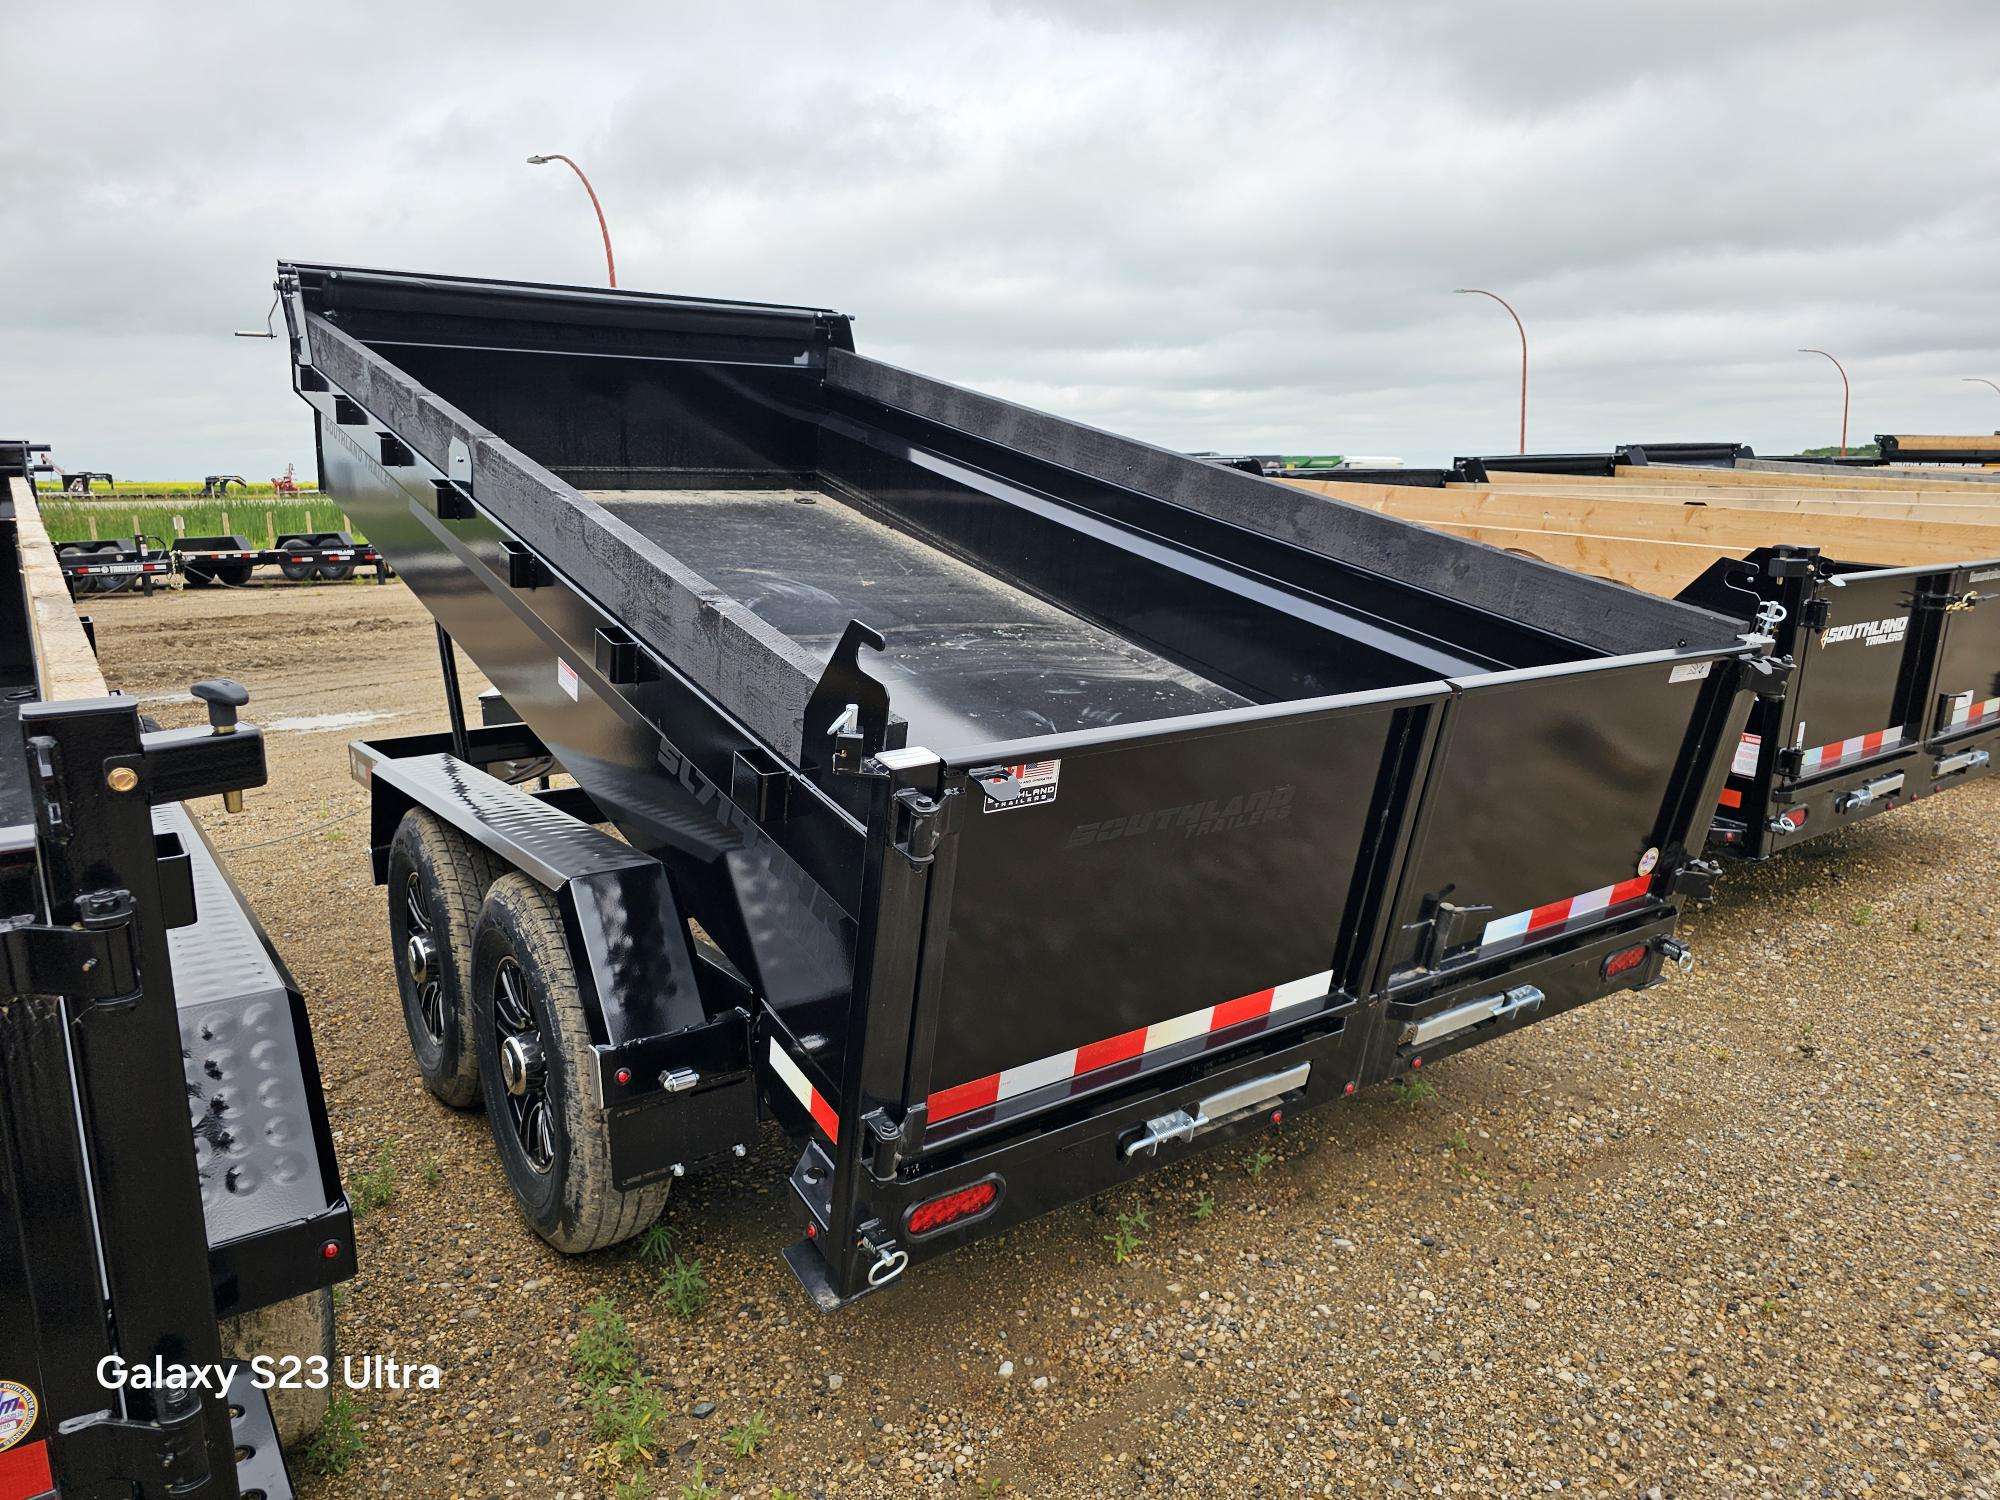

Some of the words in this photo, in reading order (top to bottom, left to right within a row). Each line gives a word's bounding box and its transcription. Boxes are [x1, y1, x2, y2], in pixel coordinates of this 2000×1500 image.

[1826, 616, 1909, 644] SOUTHLAND
[1865, 632, 1905, 647] TRAILERS
[1069, 784, 1296, 847] SOUTHLAND
[1185, 804, 1292, 839] TRAILERS
